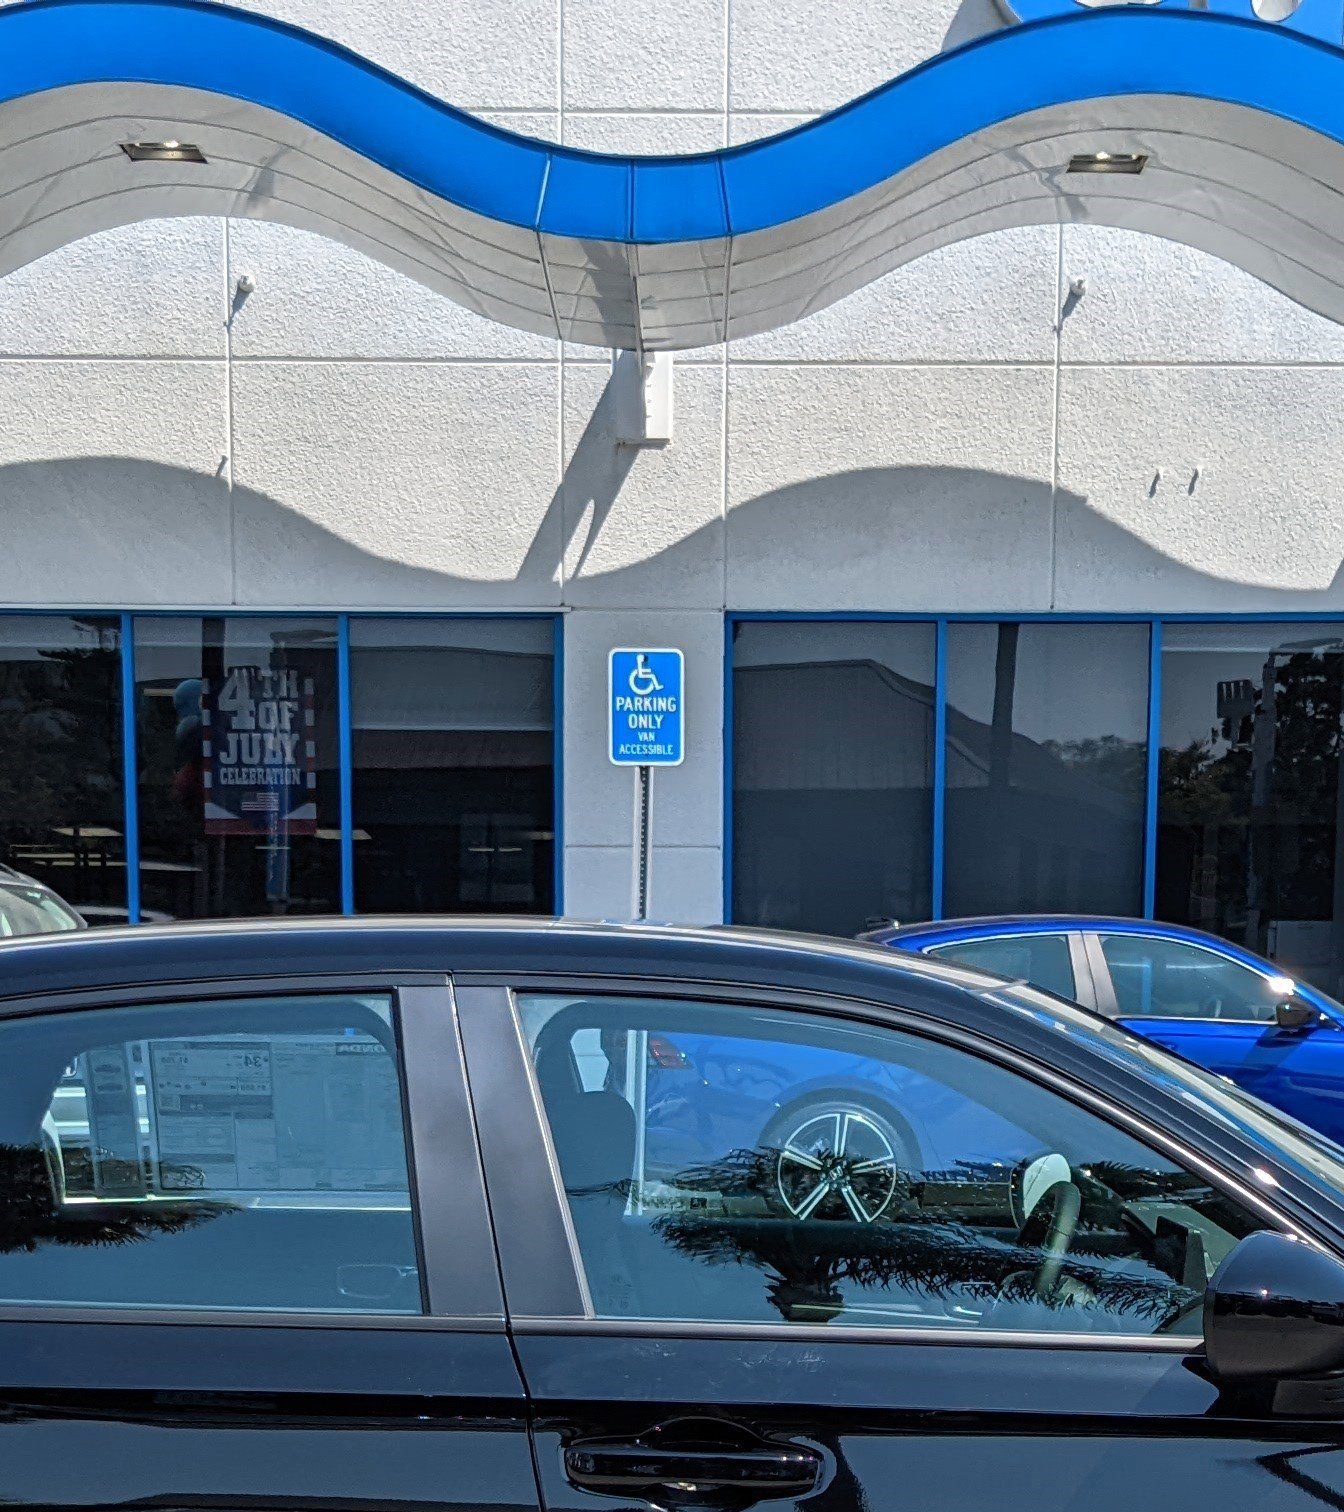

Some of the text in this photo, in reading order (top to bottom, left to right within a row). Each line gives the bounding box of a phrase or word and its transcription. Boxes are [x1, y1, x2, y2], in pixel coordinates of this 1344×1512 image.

[616, 697, 676, 712] PARKING
[258, 701, 299, 731] OF
[628, 714, 664, 729] ONLY
[637, 731, 656, 741] VAN
[219, 733, 301, 765] JULY
[618, 744, 674, 755] ACCESSIBLE
[219, 768, 302, 785] CELEBRATION
